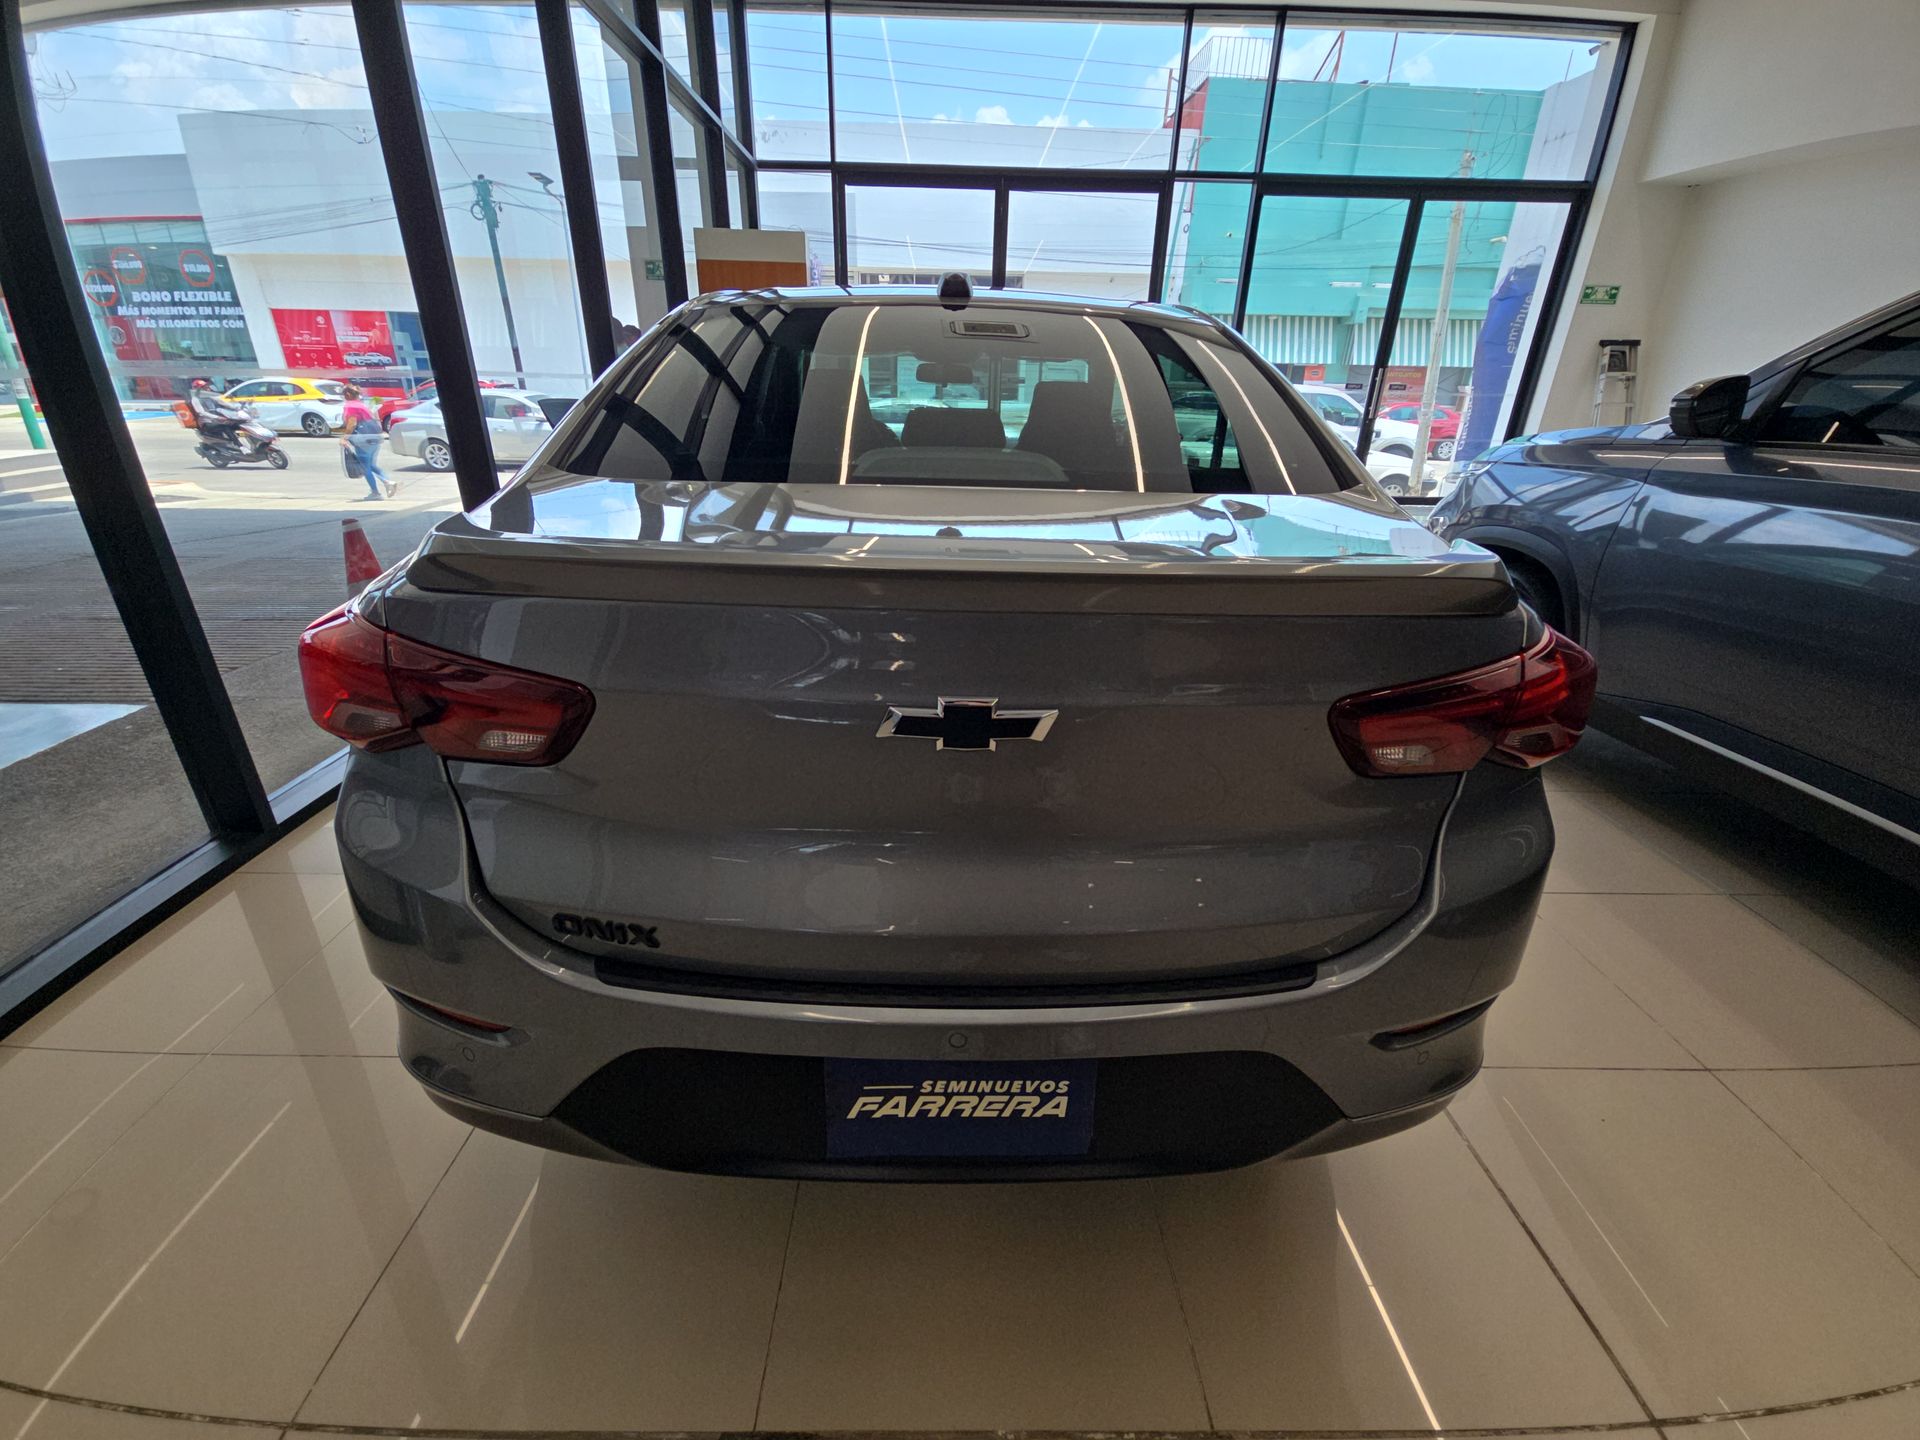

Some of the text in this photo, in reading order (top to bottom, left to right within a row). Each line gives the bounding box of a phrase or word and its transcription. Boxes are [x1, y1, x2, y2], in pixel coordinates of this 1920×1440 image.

[131, 291, 232, 302] BONO FLEXIBLE
[141, 306, 197, 316] MOMENTOS
[199, 306, 212, 316] EN
[222, 319, 244, 328] CON
[552, 912, 660, 948] ONIX
[920, 1080, 1070, 1093] SEMINUEVOS
[846, 1095, 1070, 1119] FARRERA
